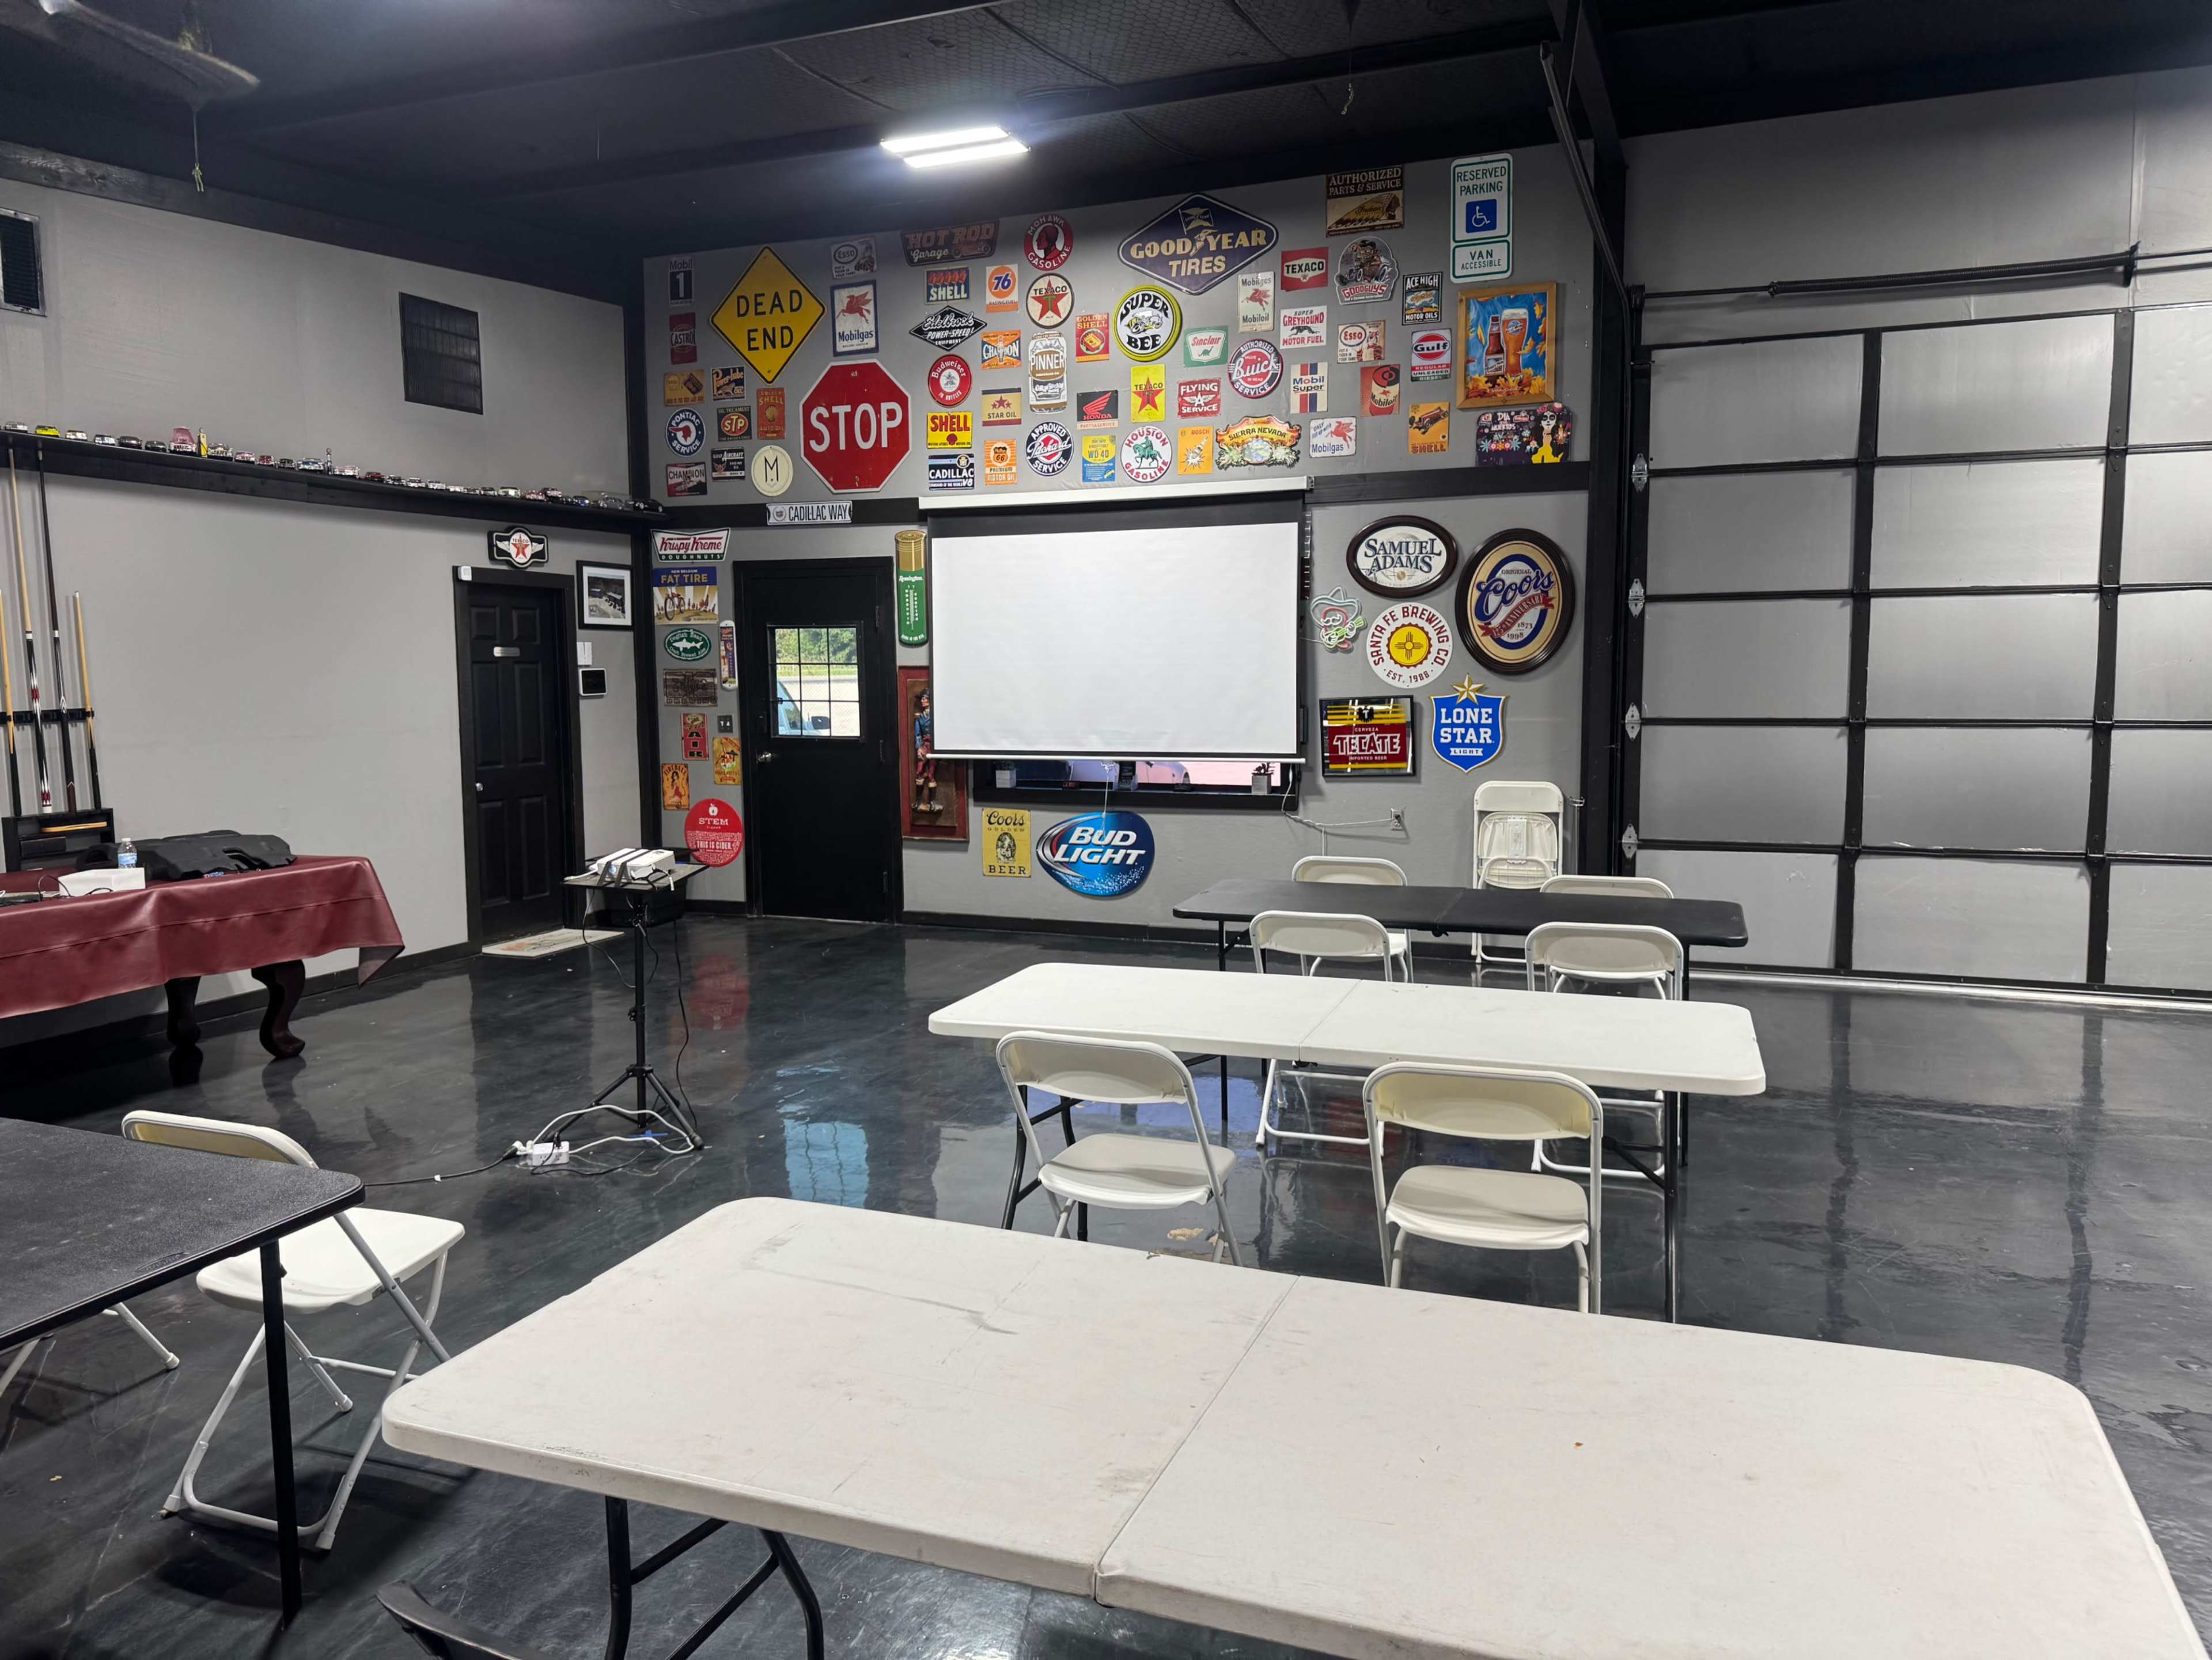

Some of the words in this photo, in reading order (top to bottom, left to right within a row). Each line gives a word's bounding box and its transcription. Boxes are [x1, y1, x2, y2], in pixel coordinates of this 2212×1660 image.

[1329, 168, 1402, 186] AUTHORIZED
[1456, 166, 1506, 183] RESERVED
[1329, 185, 1355, 196] PARTS
[1366, 179, 1401, 191] SERVICE
[1460, 181, 1503, 196] PARKING
[1028, 214, 1065, 236] MOHAWK
[905, 229, 950, 250] HOT
[951, 223, 995, 244] ROD
[910, 248, 949, 263] Garage
[1028, 245, 1071, 269] GASOLINE
[1470, 249, 1493, 260] VAN
[669, 260, 693, 270] Mobil
[1169, 255, 1226, 277] TIRES
[1285, 260, 1324, 274] TEXACO
[1461, 258, 1502, 271] ACCESSIBLE
[676, 272, 684, 298] 1
[991, 273, 1012, 292] 76
[1241, 278, 1271, 287] Mobilgas
[1406, 277, 1419, 290] ACE
[1420, 274, 1438, 288] HIGH
[929, 284, 967, 301] SHELL
[1033, 285, 1067, 296] TEXACO
[1341, 285, 1388, 298] GOODGUYS
[736, 289, 803, 318] DEAD
[1120, 293, 1171, 323] SUPER
[922, 312, 975, 331] Edelbrock
[1077, 314, 1108, 322] GOLDEN
[1077, 320, 1107, 329] SHELL
[1243, 313, 1269, 323] Mobiloil
[1283, 312, 1324, 327] GREYHOUND
[1406, 313, 1424, 321] MOTOR
[671, 330, 696, 346] CASTROL
[747, 325, 794, 351] END
[838, 330, 874, 342] Mobilgas
[1126, 334, 1162, 351] BEE
[1191, 335, 1222, 346] Sinclair
[1282, 337, 1305, 346] MOTOR
[1307, 335, 1324, 343] FUEL
[983, 340, 1019, 359] CHAION
[1240, 340, 1274, 353] AUTHORIZED
[1414, 342, 1448, 351] Gulf
[1031, 353, 1065, 370] PINNER
[1232, 353, 1277, 381] Buick
[931, 360, 966, 379] Budweiser
[1134, 383, 1163, 391] TEXACO
[1234, 381, 1270, 395] SERVICE
[1293, 376, 1324, 385] Mobil
[1181, 383, 1218, 396] FLYING
[1293, 384, 1324, 393] Super
[759, 396, 784, 405] SHELL
[1181, 403, 1218, 413] SERVICE
[671, 412, 700, 427] PONTIAC
[724, 415, 745, 432] STP
[930, 413, 971, 432] SHELL
[809, 402, 903, 453] STOP
[1031, 422, 1066, 440] APPROVED
[1228, 428, 1256, 441] SIERRA
[1257, 426, 1286, 438] NEVADA
[1125, 428, 1169, 447] HOUSTON
[672, 439, 701, 454] SERVICE
[1027, 436, 1071, 460] Packard
[1312, 443, 1344, 454] Mobilgas
[1412, 443, 1446, 454] SHELL
[722, 451, 744, 462] AIRCRAFT
[1033, 458, 1067, 473] SERVICE
[1125, 460, 1169, 480] GASOLINE
[668, 469, 704, 480] CHAMION
[929, 468, 975, 479] CADILLAC
[962, 478, 974, 487] V8
[789, 505, 827, 522] CADILLAC
[828, 504, 848, 520] WAY
[660, 536, 691, 553] Krispy
[691, 536, 723, 551] Kreme
[1364, 538, 1442, 558] SAMUEL
[1368, 555, 1433, 576] ADAMS
[661, 574, 681, 584] FAT
[683, 574, 708, 583] TIRE
[1476, 569, 1555, 622] Coors
[1505, 593, 1544, 626] ANNIVERSARY
[670, 633, 688, 642] Dogfish
[690, 630, 703, 641] Head
[1370, 624, 1387, 666] SANTA
[1382, 610, 1399, 626] FE
[1402, 606, 1449, 644] BREWING
[1431, 648, 1449, 666] CO.
[1507, 632, 1524, 640] 1998
[1386, 670, 1405, 683] EST.
[1409, 670, 1430, 683] 1988
[1362, 709, 1369, 719] T
[1440, 708, 1493, 724] LONE
[1440, 727, 1493, 744] STAR
[1332, 732, 1401, 755] TECATE
[699, 817, 729, 826] STEM
[986, 811, 1025, 826] Coors
[1069, 826, 1137, 846] BUD
[696, 840, 709, 849] THIS
[709, 841, 714, 849] IS
[716, 841, 732, 849] CIDER.
[1054, 844, 1146, 865] LIGHT
[988, 865, 1027, 875] BEER
